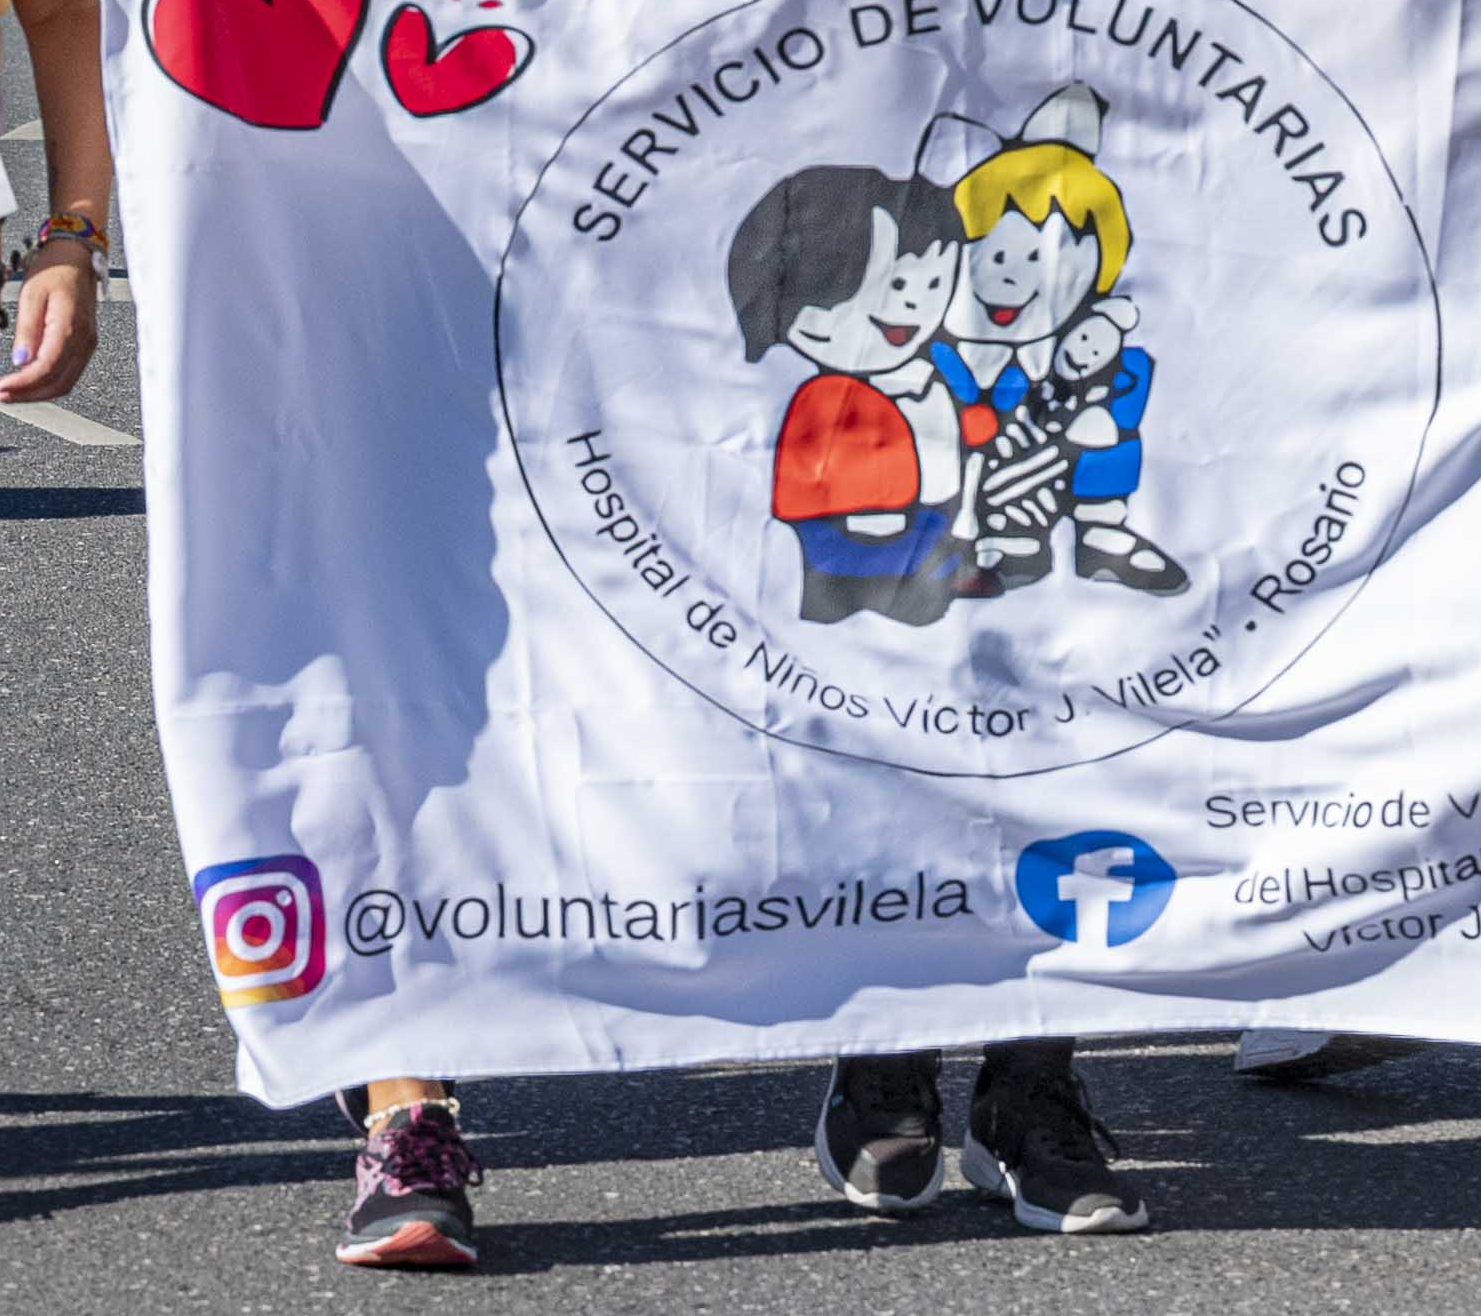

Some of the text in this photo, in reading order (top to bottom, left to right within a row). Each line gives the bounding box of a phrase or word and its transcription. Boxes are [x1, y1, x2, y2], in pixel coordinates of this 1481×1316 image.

[572, 26, 825, 243] SERVICIO
[566, 429, 690, 598] Hospital
[685, 599, 738, 649] de
[743, 640, 870, 719] Niños
[1249, 460, 1367, 614] Rosario
[1205, 791, 1374, 830] Servicio
[1380, 790, 1431, 829] de
[342, 871, 976, 959] @voluntariasvilela
[1234, 867, 1294, 905] del
